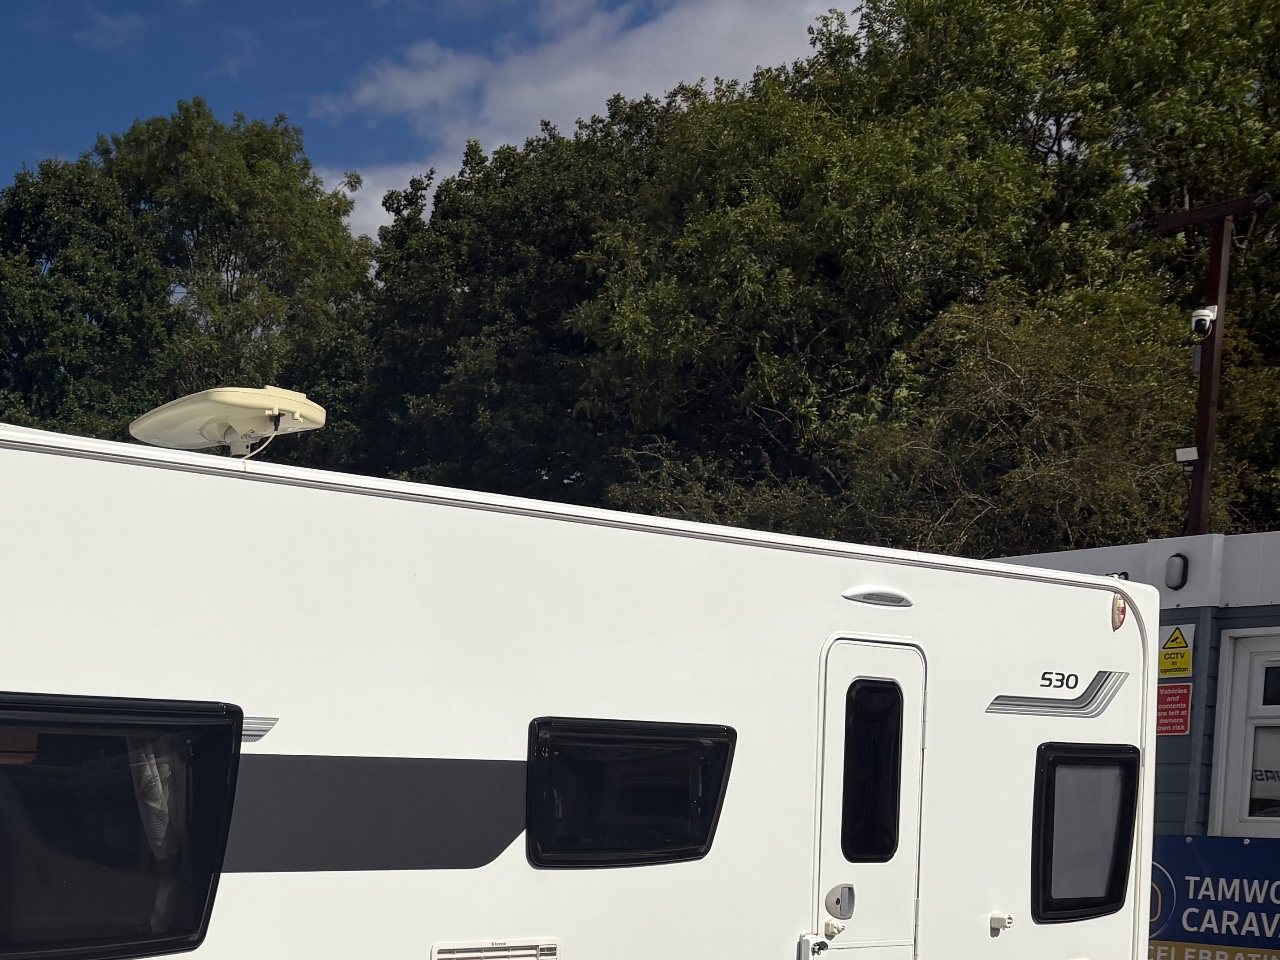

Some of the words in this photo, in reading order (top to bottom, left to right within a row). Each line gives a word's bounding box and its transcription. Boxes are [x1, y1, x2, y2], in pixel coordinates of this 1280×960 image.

[1163, 652, 1185, 660] CCTV
[1160, 666, 1188, 674] operation
[1040, 672, 1079, 689] 530
[1181, 907, 1280, 939] CARAV
